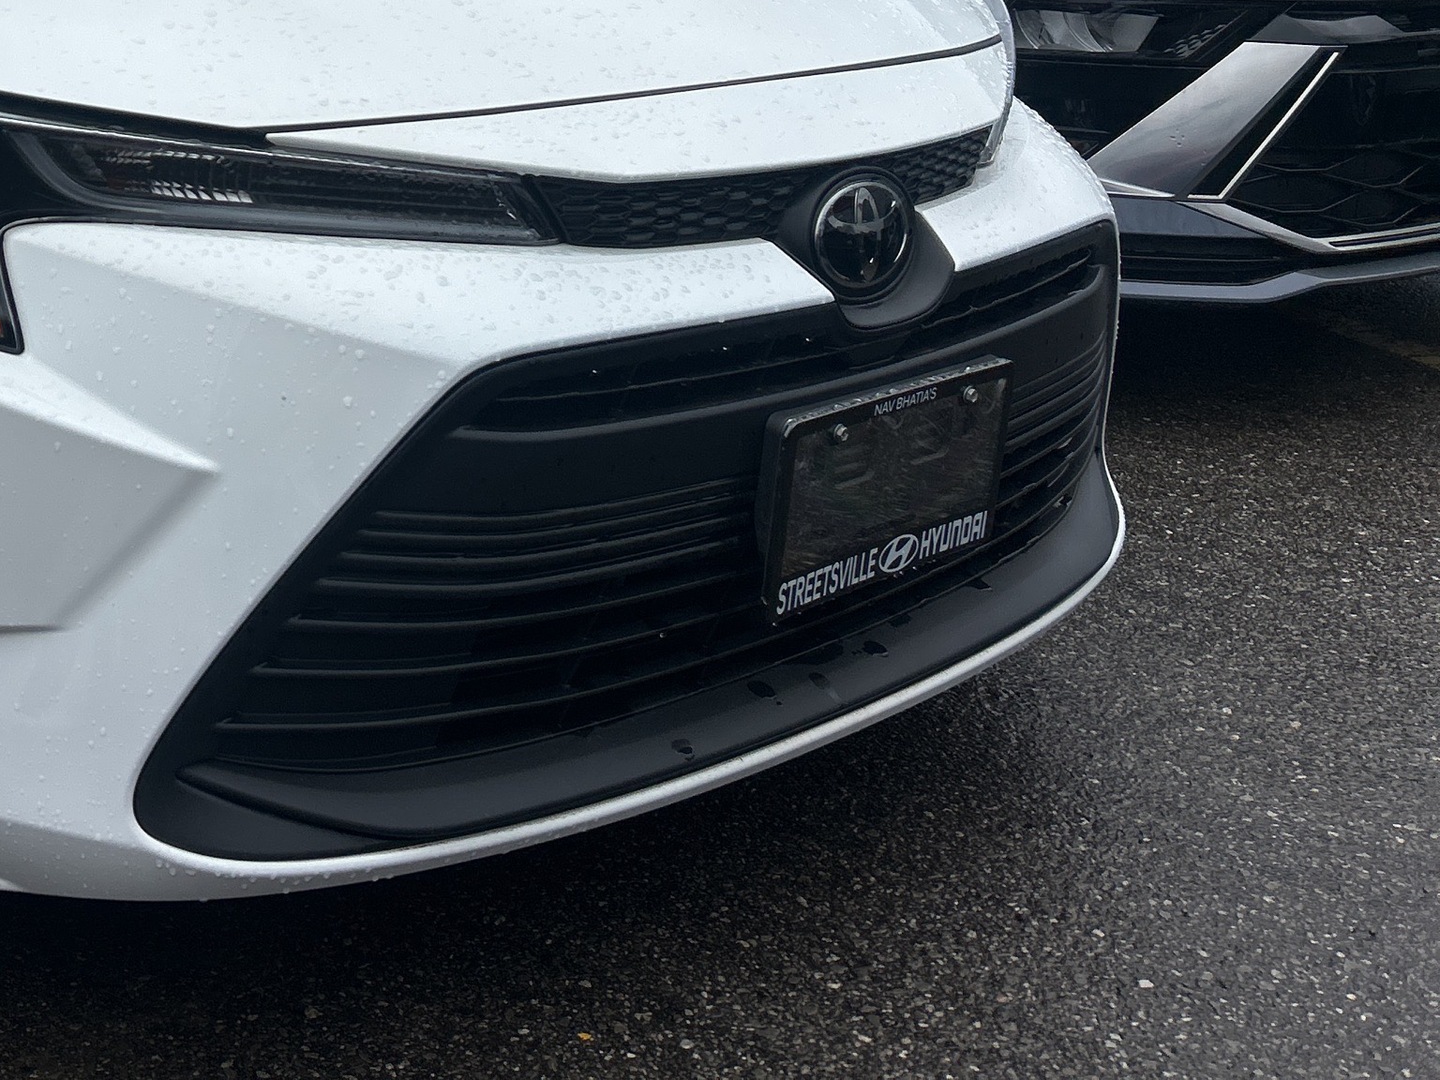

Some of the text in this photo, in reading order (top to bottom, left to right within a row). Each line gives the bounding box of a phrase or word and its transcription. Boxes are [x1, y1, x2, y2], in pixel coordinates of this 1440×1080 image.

[874, 387, 938, 416] NAV BHATIA'S
[776, 511, 988, 615] STREETSVILLE HYUNDAI
